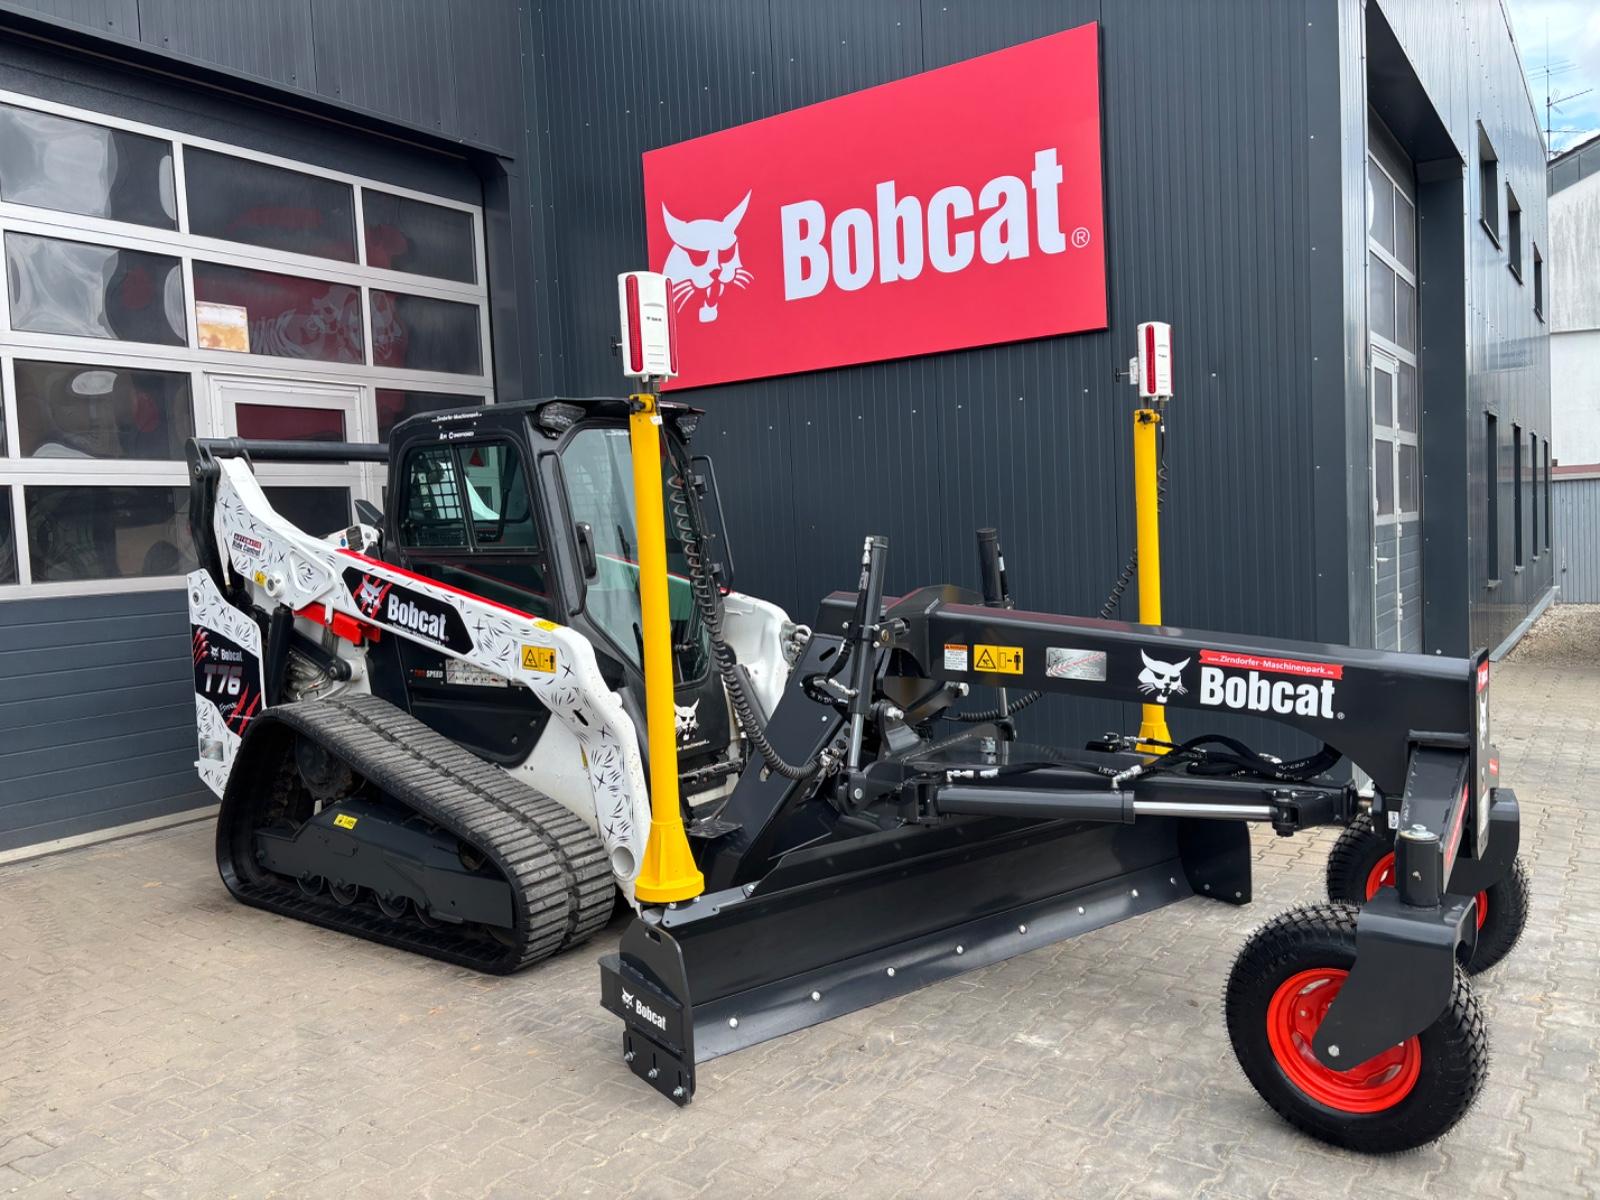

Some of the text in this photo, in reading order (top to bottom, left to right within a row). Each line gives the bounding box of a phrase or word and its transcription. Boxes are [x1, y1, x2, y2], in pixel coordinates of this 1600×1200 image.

[781, 148, 1066, 301] Bobcat
[387, 593, 447, 640] Bobcat
[221, 649, 243, 662] Bobcat
[204, 663, 243, 696] T76
[1200, 666, 1335, 719] Bobcat
[635, 998, 667, 1031] Bobcat
